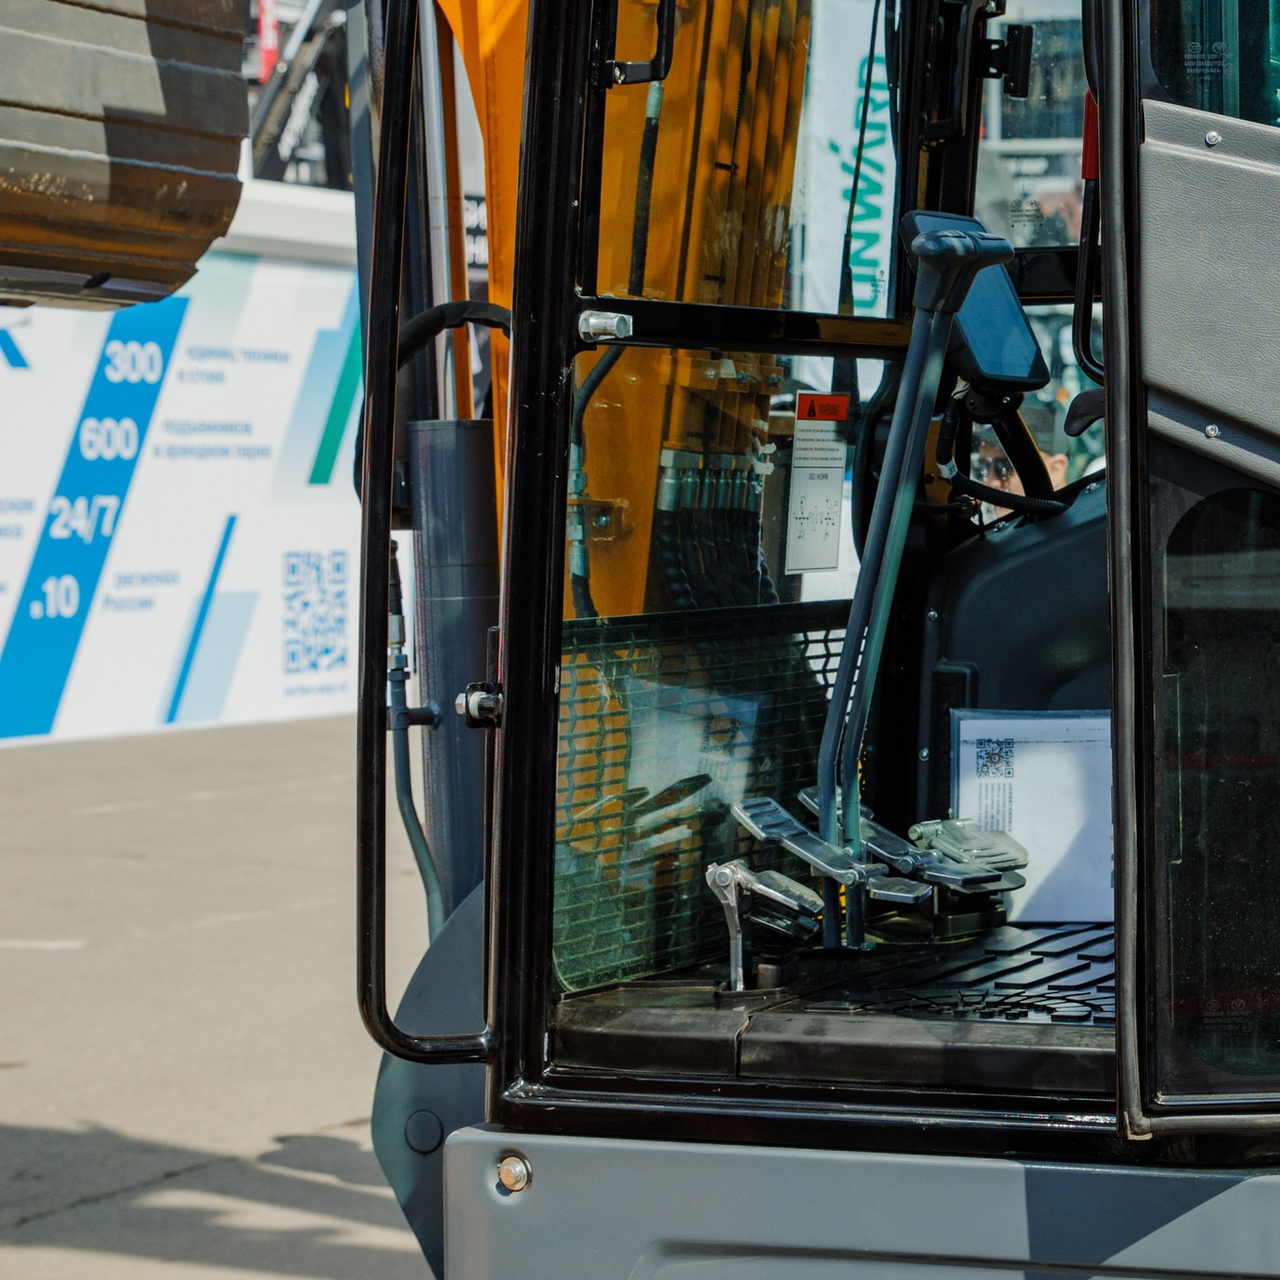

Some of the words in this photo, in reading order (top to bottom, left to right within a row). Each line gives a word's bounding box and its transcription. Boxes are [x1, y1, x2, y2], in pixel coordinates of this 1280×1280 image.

[105, 340, 164, 384] 300
[79, 418, 139, 461] 600
[49, 496, 121, 544] 24/7
[43, 575, 80, 619] 10
